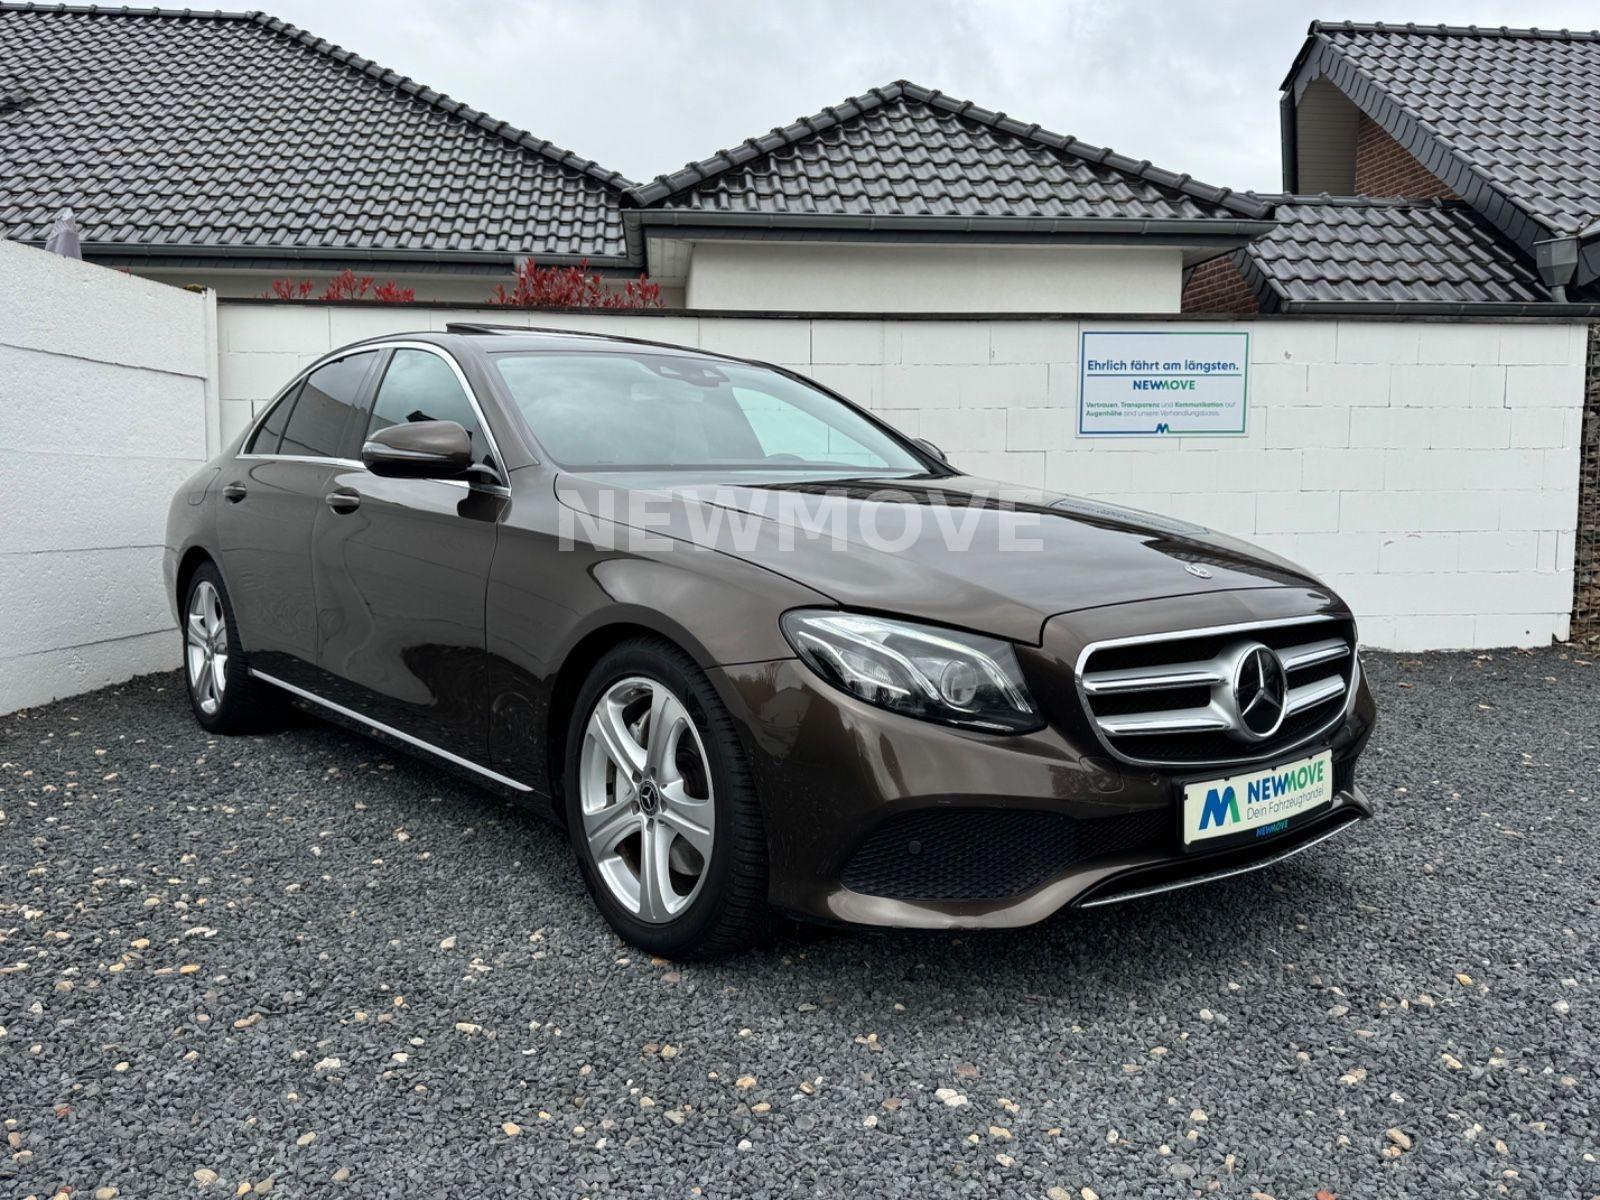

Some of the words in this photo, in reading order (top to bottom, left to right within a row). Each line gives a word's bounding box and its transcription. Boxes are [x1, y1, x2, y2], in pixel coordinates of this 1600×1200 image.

[1087, 359, 1127, 371] Ehrlich
[1131, 359, 1160, 371] fährt
[1163, 362, 1182, 371] am
[1185, 359, 1239, 373] längsten.
[1133, 380, 1196, 390] NEWMOVE
[1121, 401, 1160, 409] Transparenz
[1247, 760, 1325, 804] NEWMOVE
[1247, 805, 1267, 820] Dein
[1269, 785, 1324, 812] Fahrzeughandel
[1256, 819, 1289, 837] NEWMOVE
